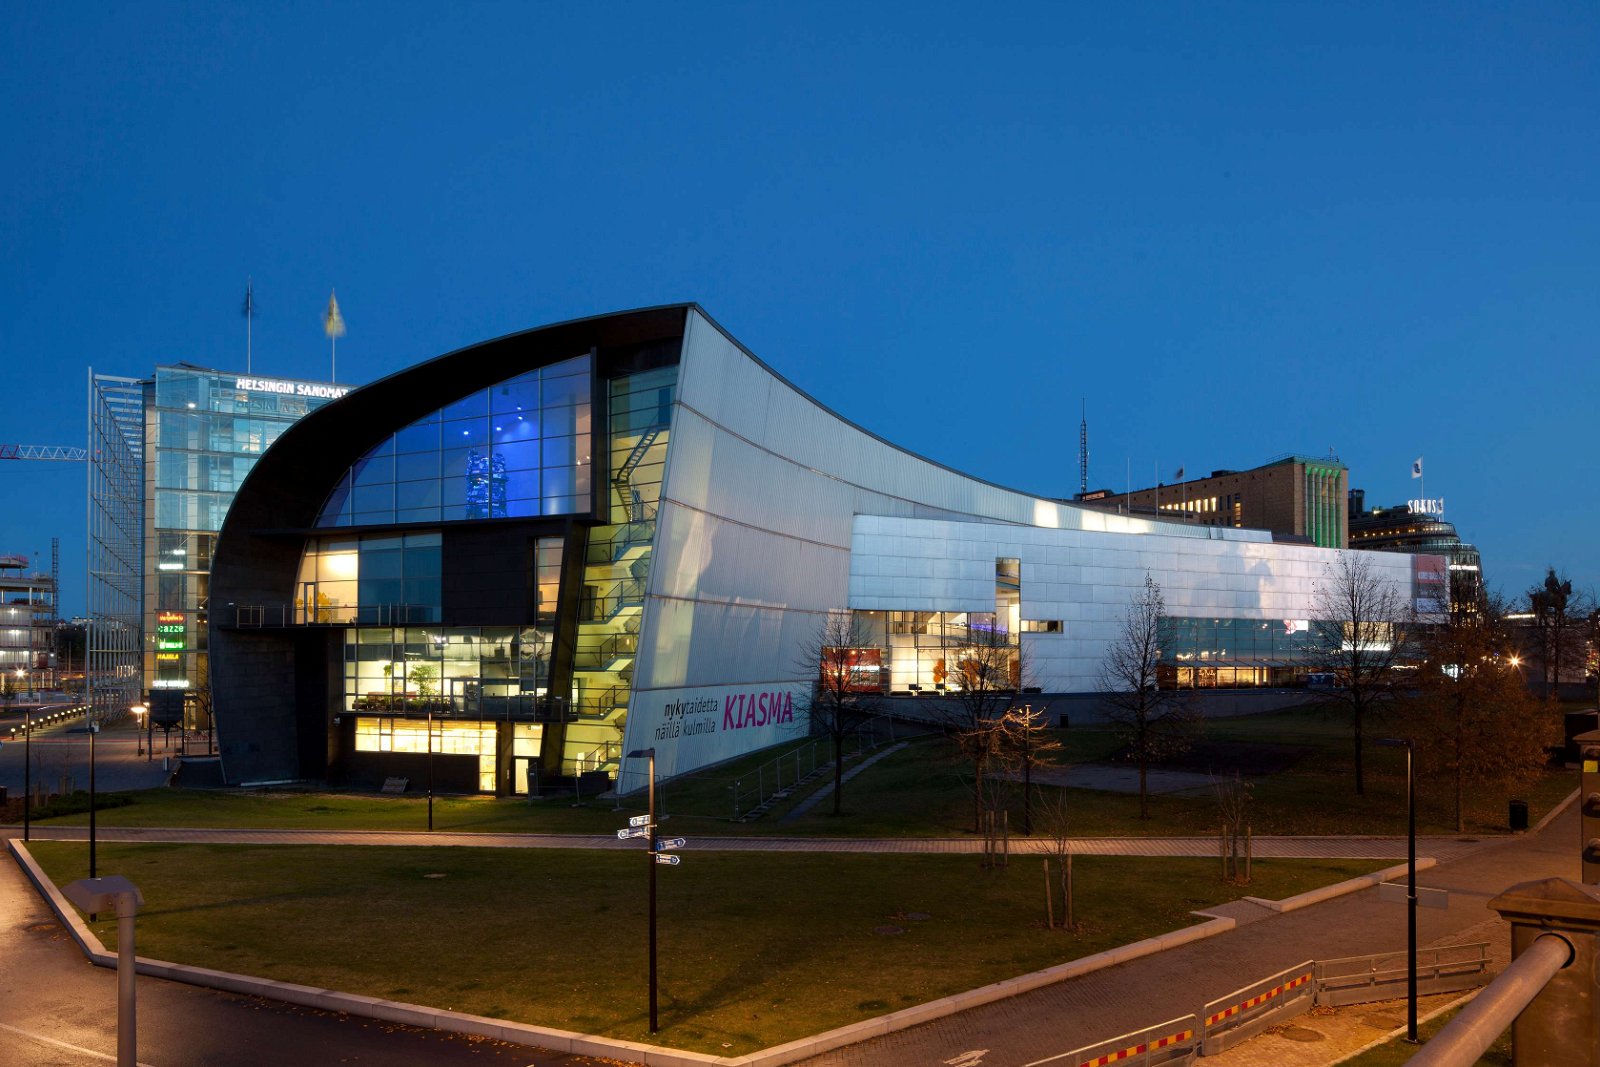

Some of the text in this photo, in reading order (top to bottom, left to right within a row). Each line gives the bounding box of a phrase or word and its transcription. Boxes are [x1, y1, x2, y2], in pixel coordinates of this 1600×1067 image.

[236, 378, 295, 394] HELSINGIN
[664, 697, 718, 719] nykytaidetta
[722, 691, 793, 731] KIASMA
[654, 718, 715, 740] näillä kulmilla
